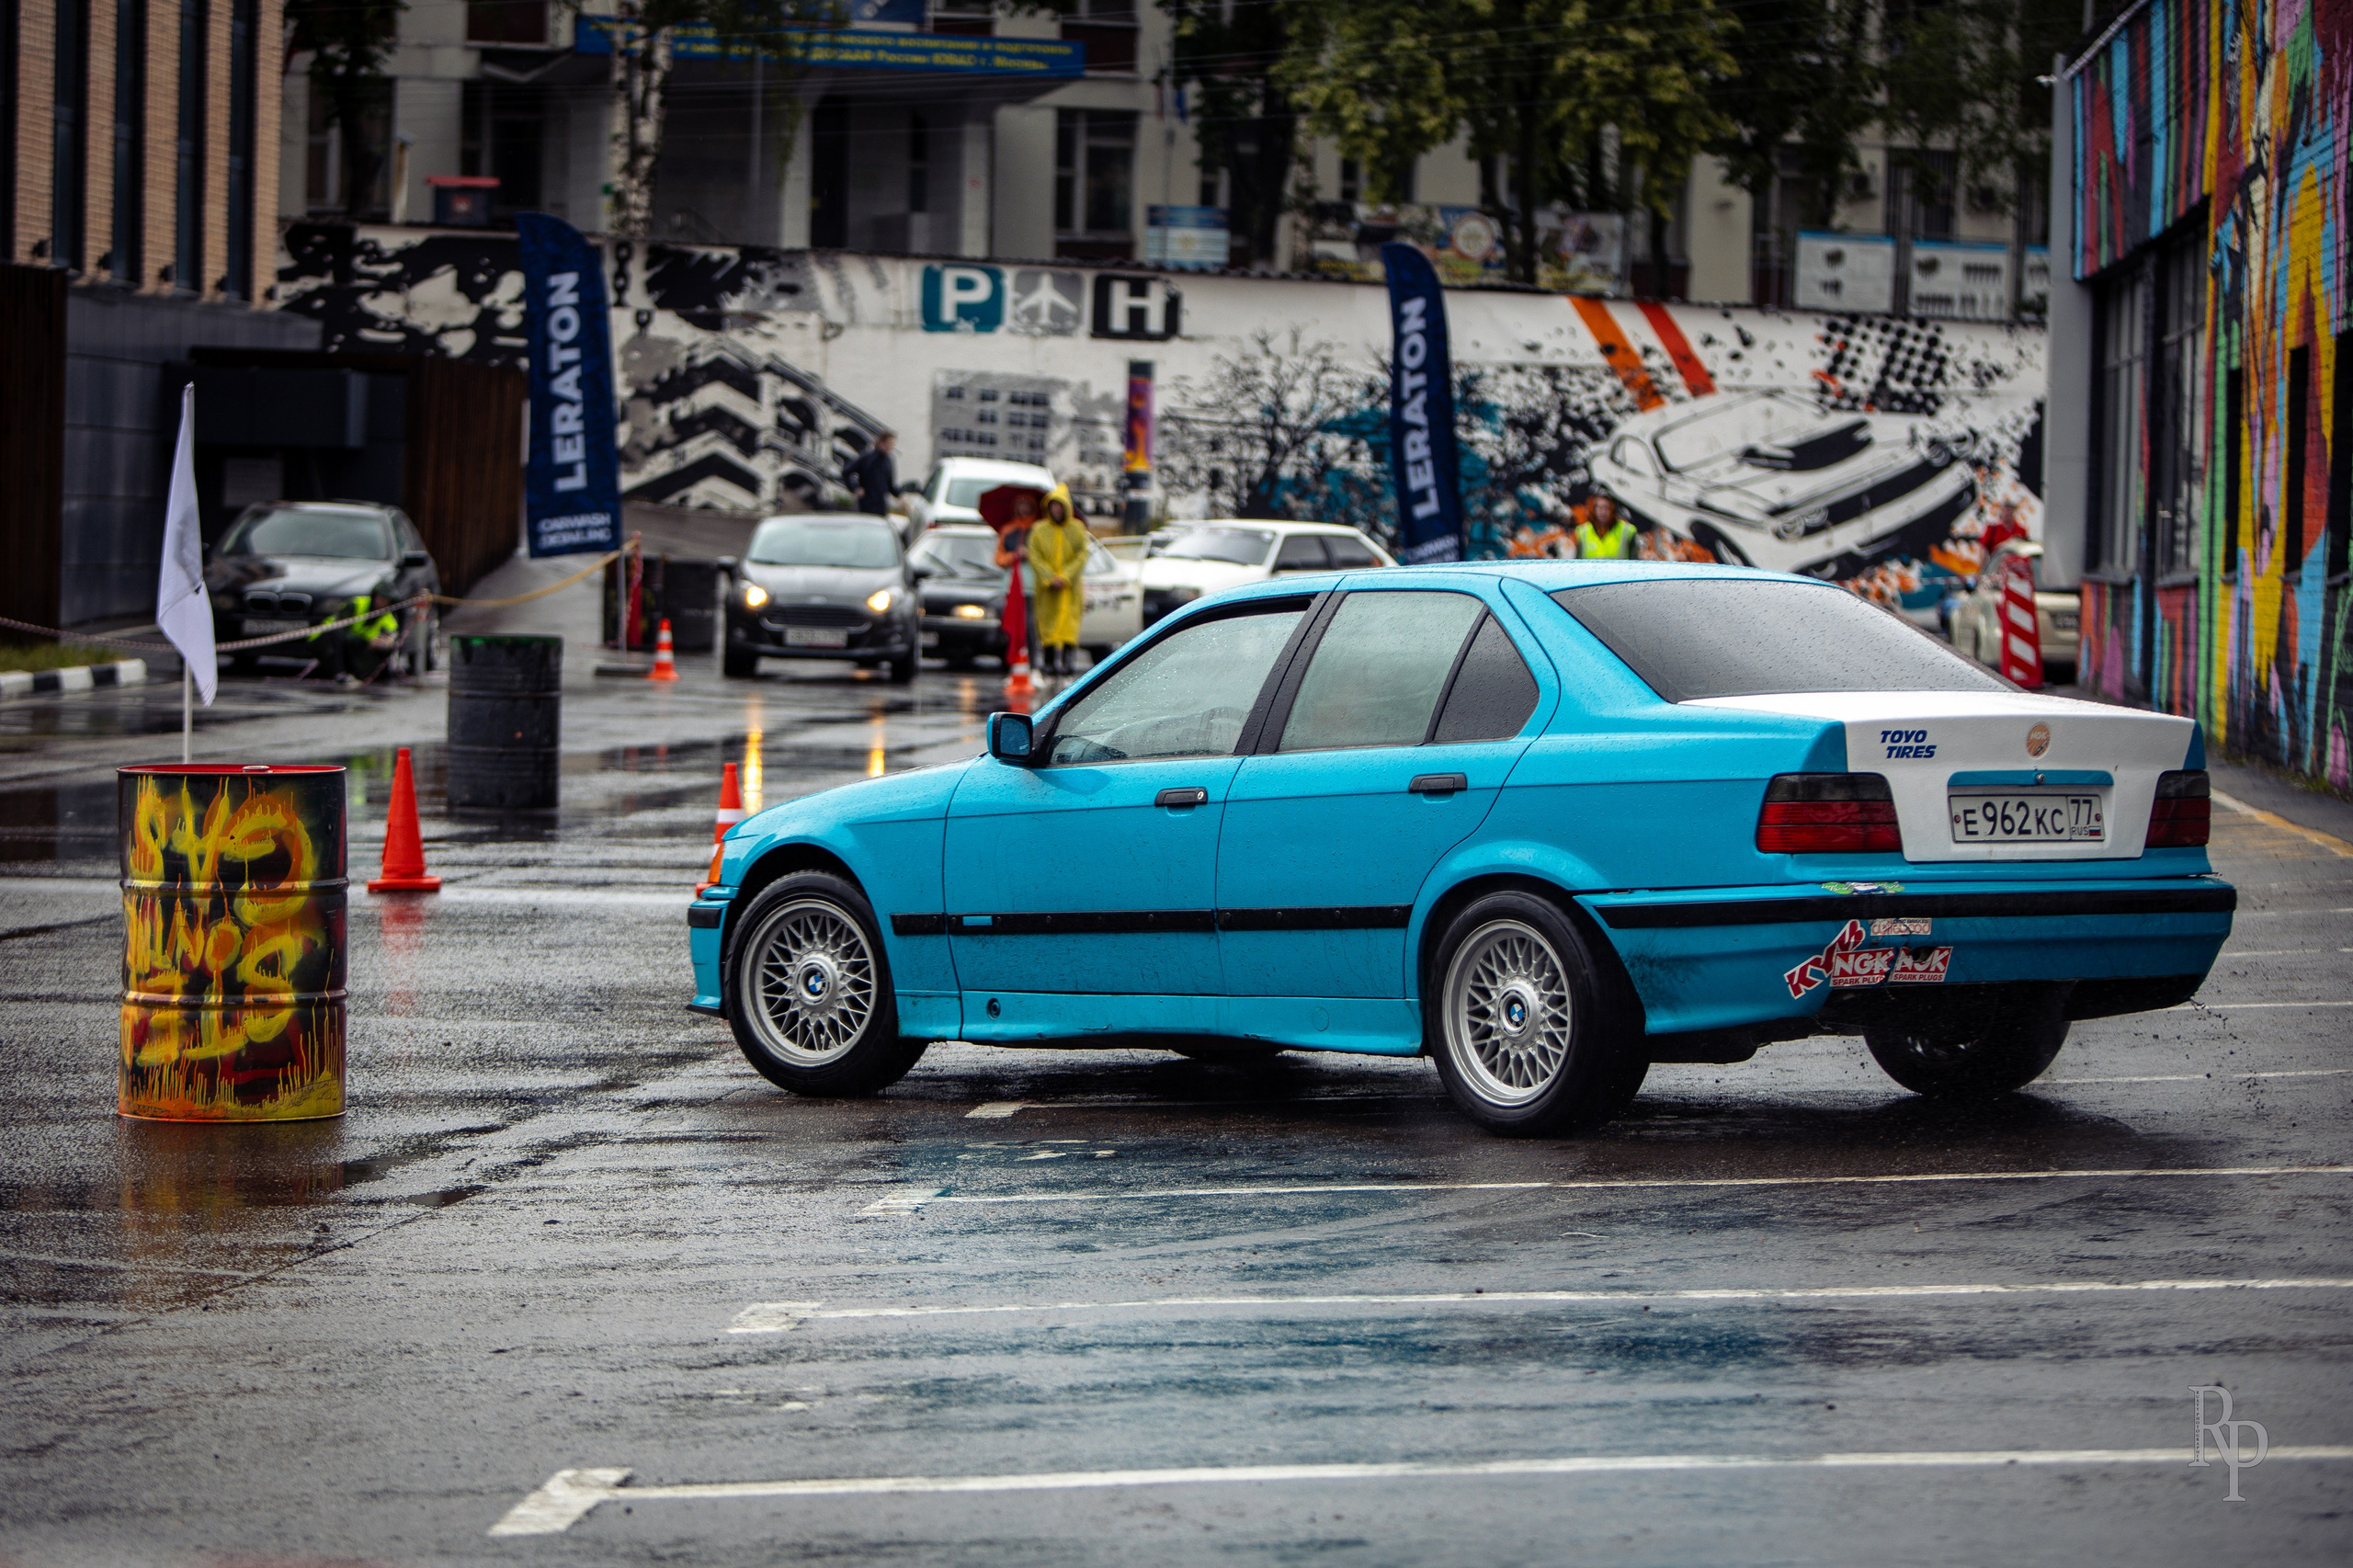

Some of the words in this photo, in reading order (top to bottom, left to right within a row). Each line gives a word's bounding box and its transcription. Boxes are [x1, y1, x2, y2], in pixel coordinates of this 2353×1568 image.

[939, 267, 994, 323] P
[1109, 280, 1167, 335] H
[546, 270, 588, 494] LERATON
[1399, 295, 1440, 520] LERATON
[1880, 730, 1927, 744] TOYO
[1886, 744, 1937, 759] TIRES
[2070, 799, 2093, 825] 77
[2071, 826, 2089, 836] RUS
[1834, 949, 1895, 977] NGK
[1832, 977, 1860, 986] SPARK
